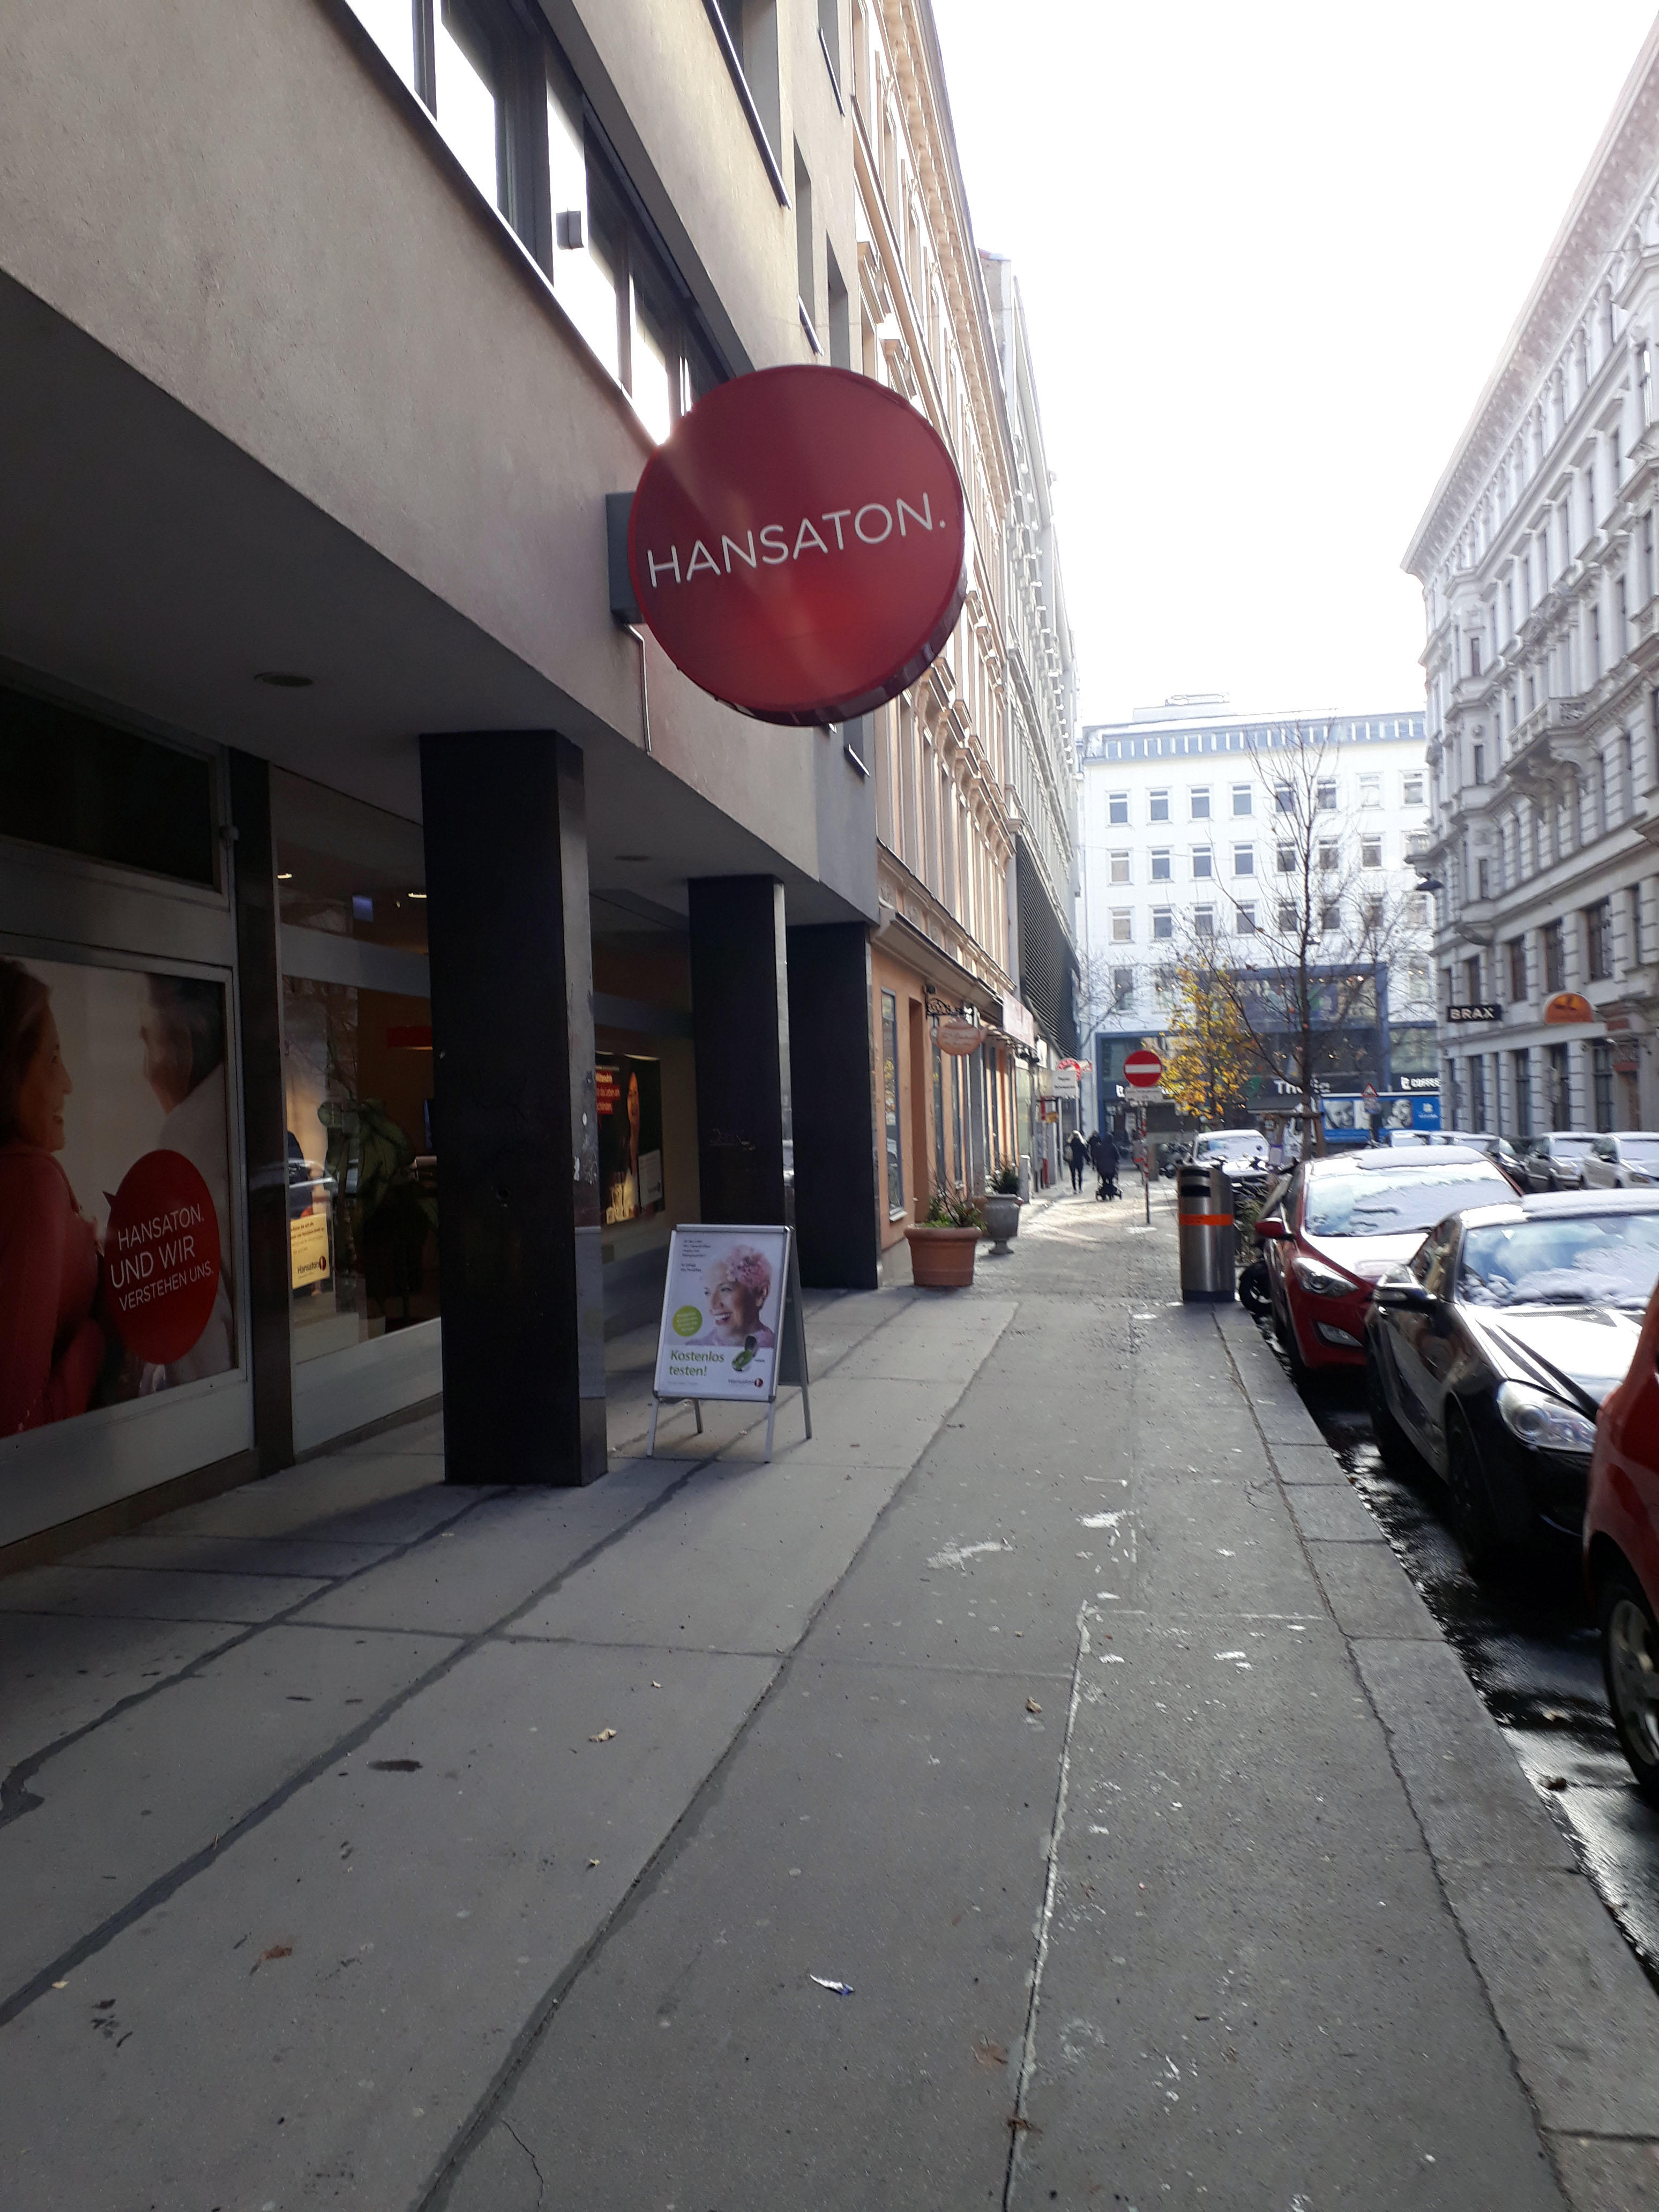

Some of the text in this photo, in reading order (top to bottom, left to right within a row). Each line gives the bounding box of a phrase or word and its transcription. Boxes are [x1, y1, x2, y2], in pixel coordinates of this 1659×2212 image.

[647, 492, 946, 588] HANSATON.
[1449, 1007, 1494, 1020] BRAX
[110, 1235, 195, 1289] UND WIR
[119, 1272, 187, 1312] VERSTEHEN
[671, 1349, 724, 1363] Kostenlos
[668, 1365, 707, 1377] testen!
